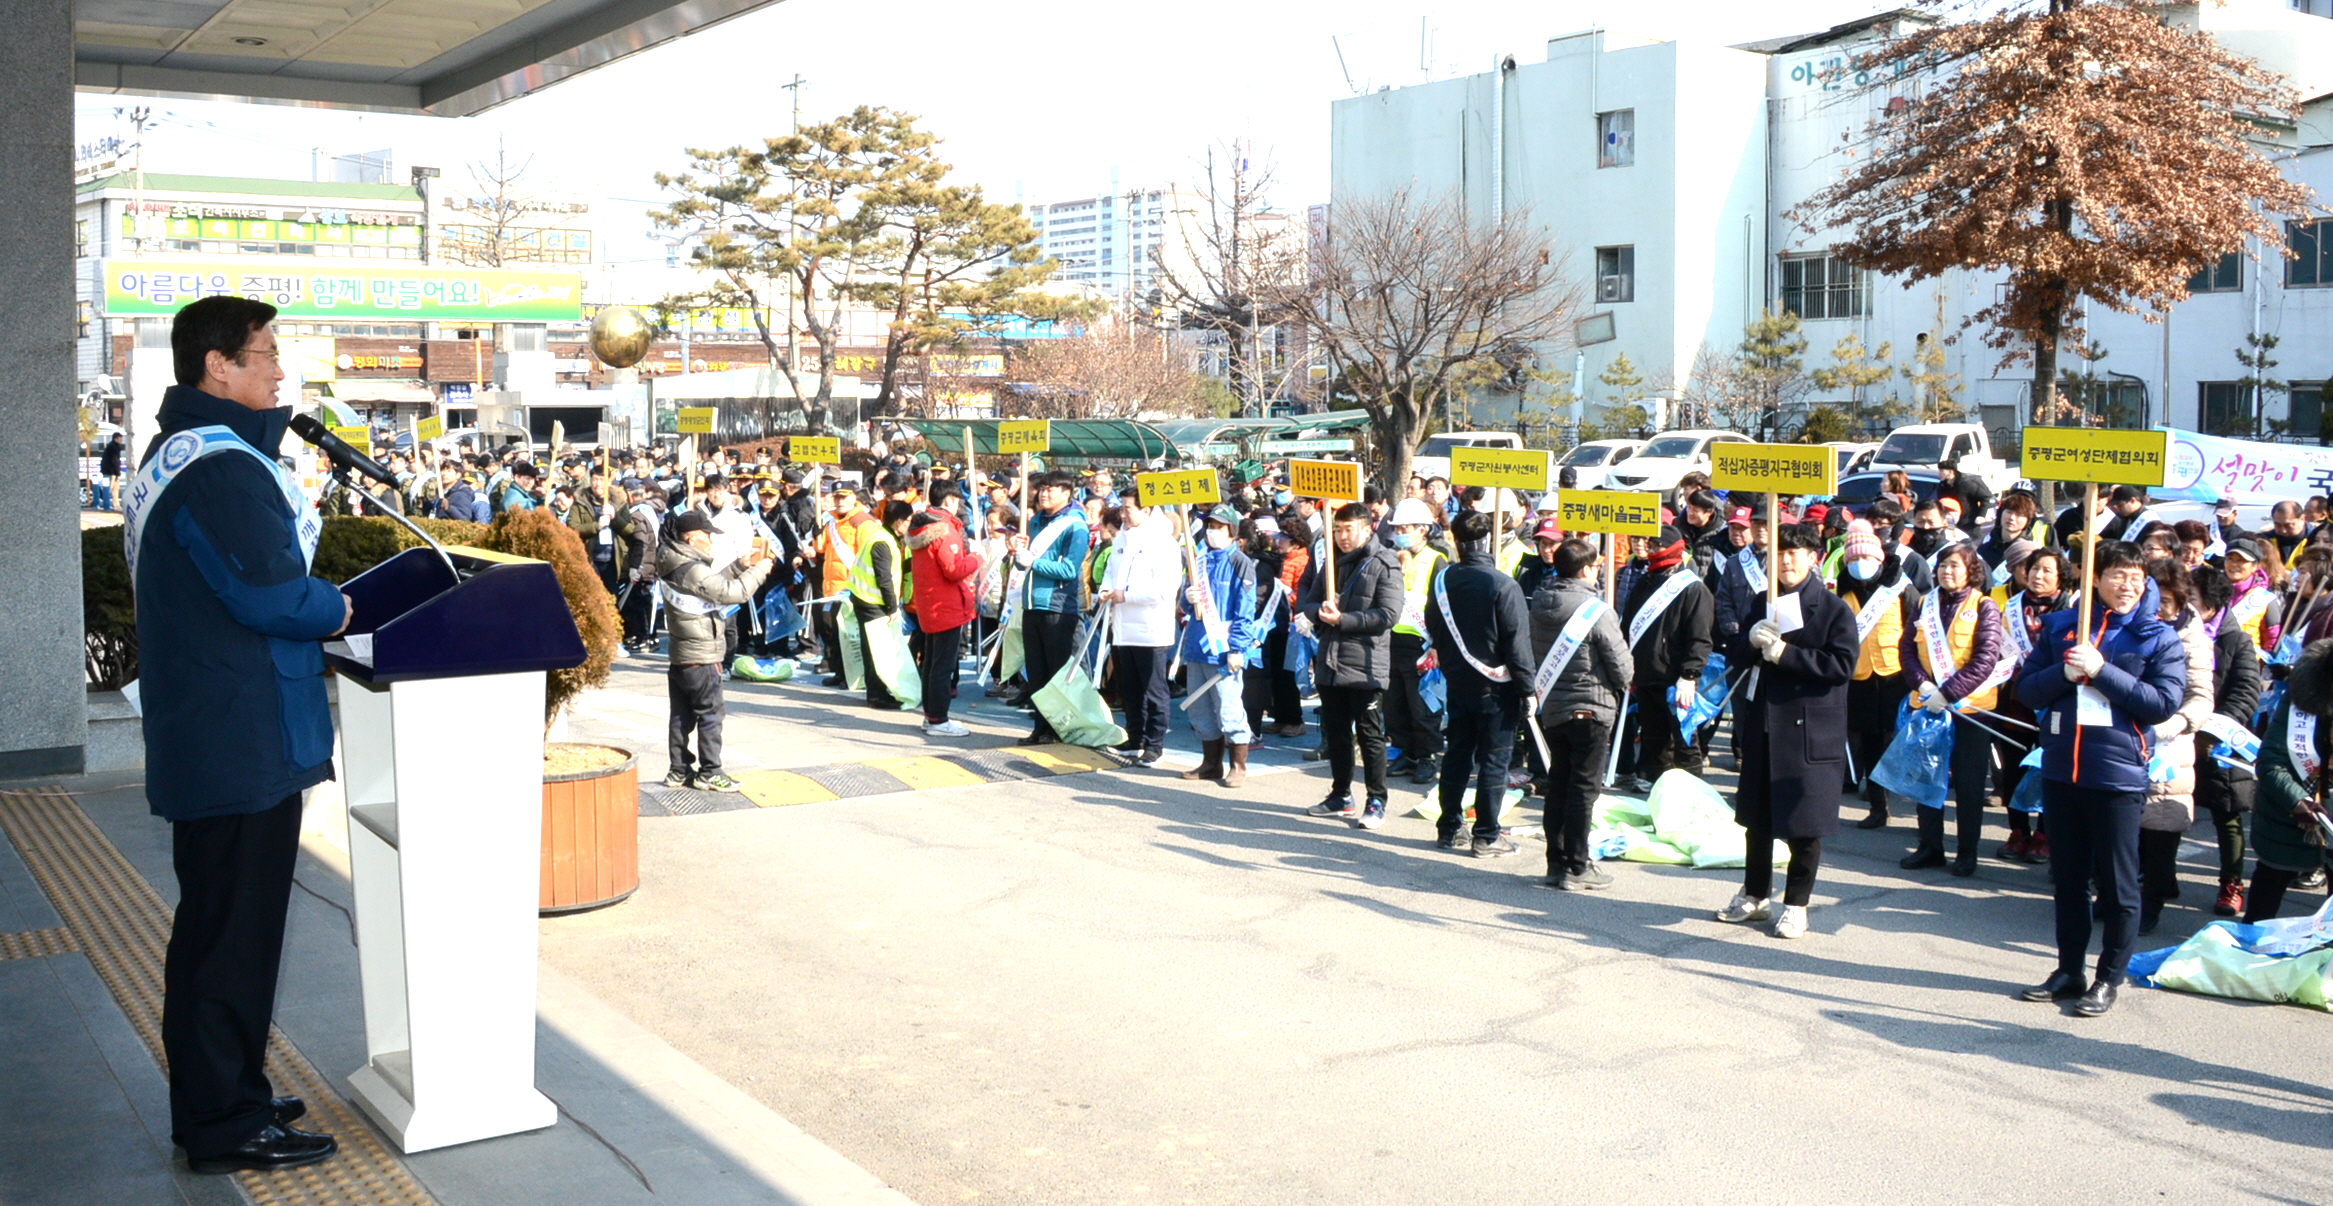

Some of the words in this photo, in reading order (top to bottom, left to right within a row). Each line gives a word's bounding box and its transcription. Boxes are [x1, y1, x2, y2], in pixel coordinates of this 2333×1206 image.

[241, 276, 301, 304] 증평!
[312, 278, 361, 305] 함께
[372, 279, 478, 307] 만들어요!
[1459, 460, 1539, 476] 증평군자원봉사센터
[2028, 446, 2159, 467] 증평군여성단체협의회
[1718, 457, 1823, 480] 적십자증평지구협의회
[2211, 453, 2299, 493] 설맞이
[1562, 502, 1656, 525] 증평새마을금고
